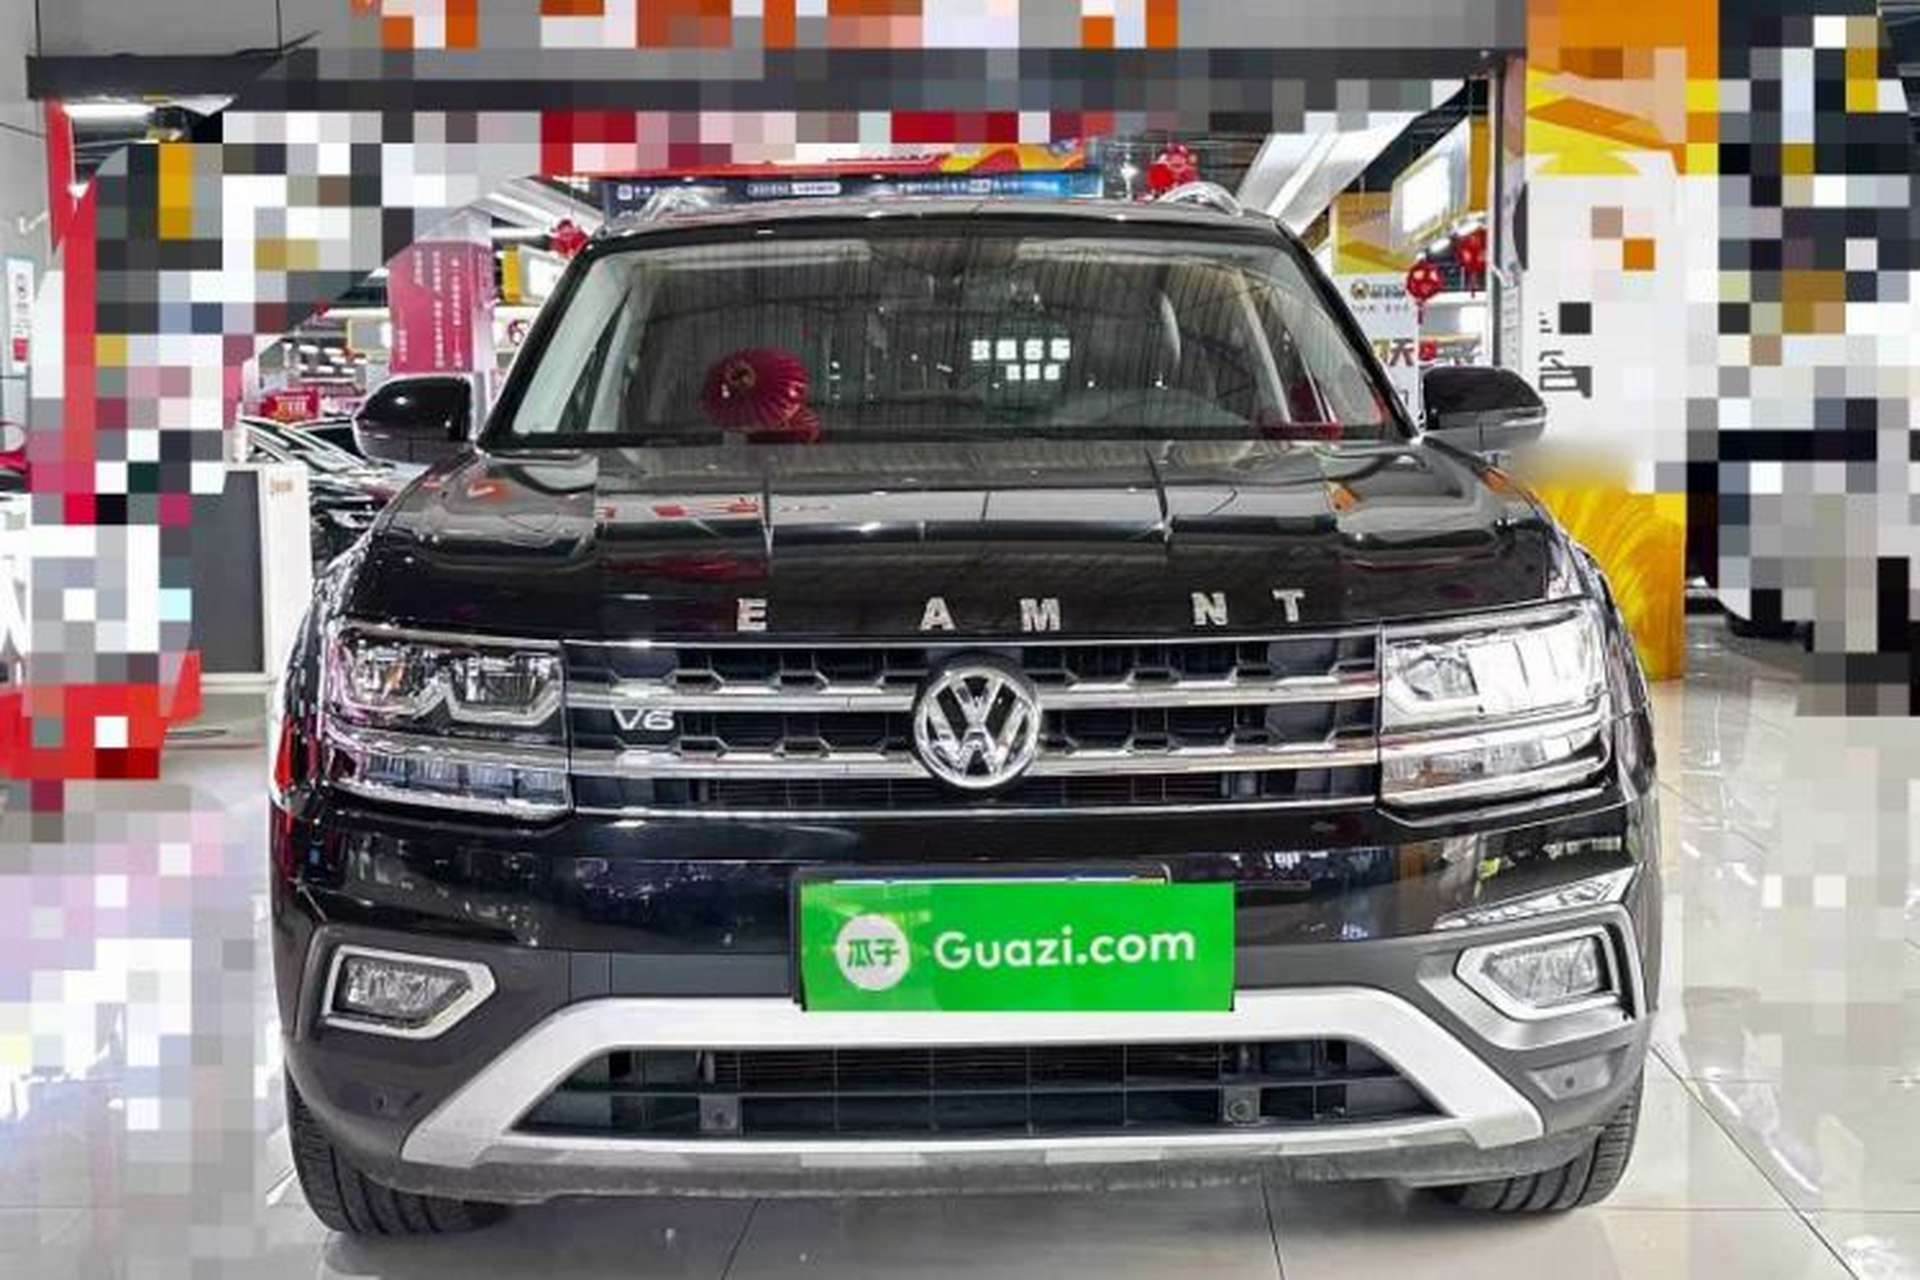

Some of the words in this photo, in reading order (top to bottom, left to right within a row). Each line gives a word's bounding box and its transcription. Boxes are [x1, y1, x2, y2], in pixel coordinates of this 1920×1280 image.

[611, 704, 675, 731] V6
[846, 937, 900, 968] 瓜子
[933, 924, 1196, 970] Guazi.com
